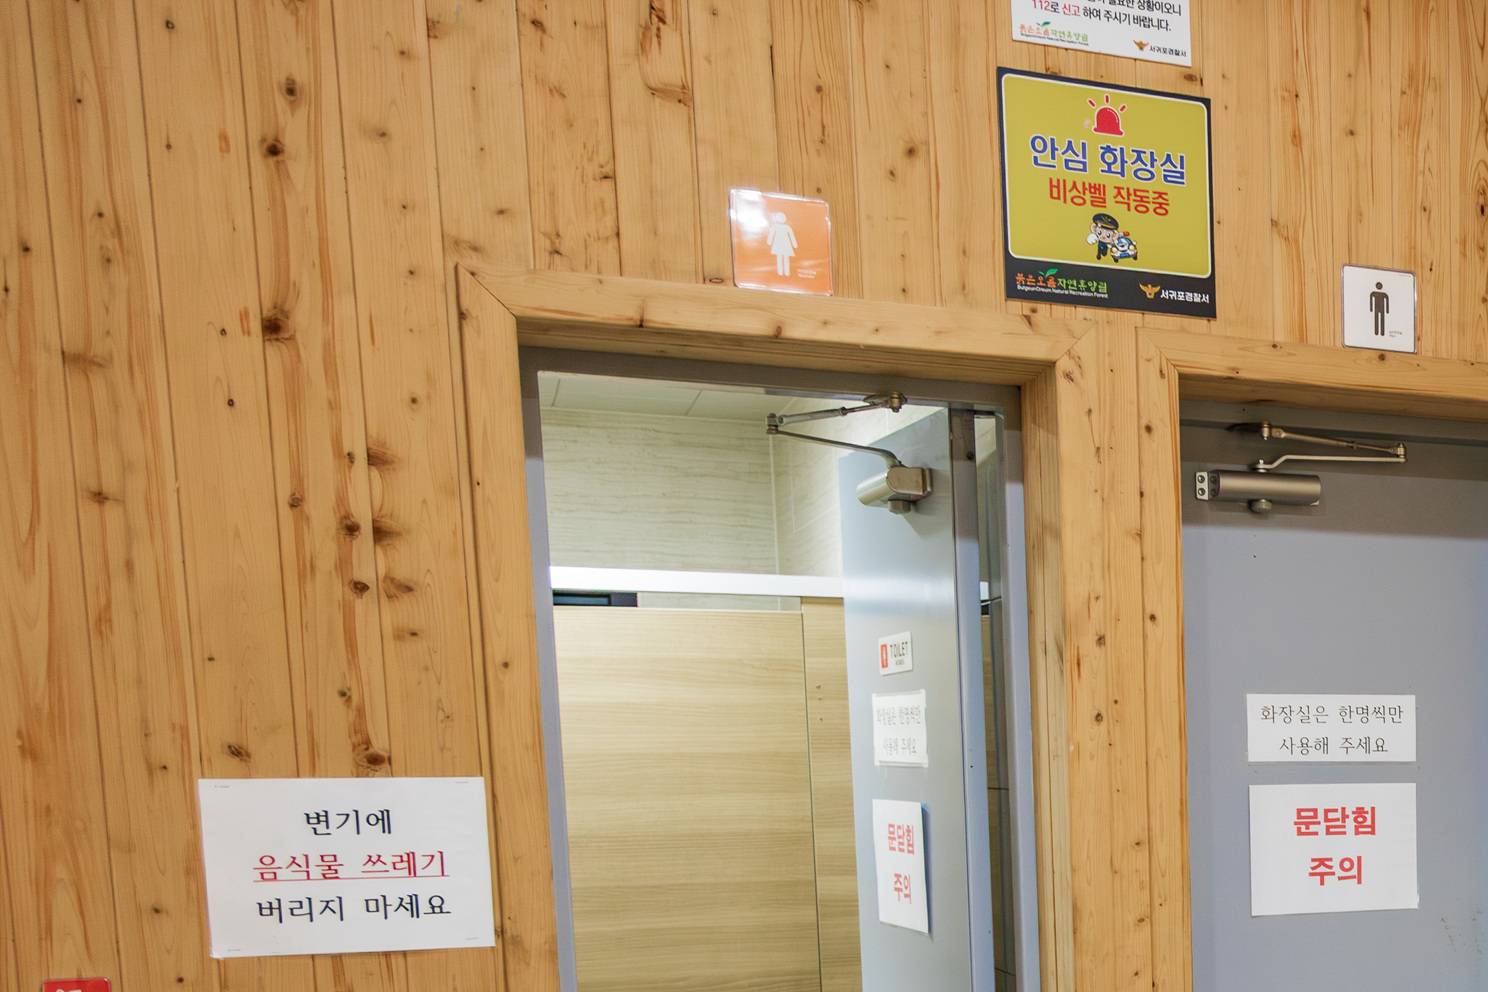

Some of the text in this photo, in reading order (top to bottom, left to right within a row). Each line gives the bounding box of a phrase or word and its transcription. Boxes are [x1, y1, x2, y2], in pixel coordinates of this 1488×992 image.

[1031, 0, 1172, 32] 112로 신고 하여 주시기 바랍니다.
[1029, 134, 1187, 187] 안심 화장실
[1049, 176, 1170, 217] 비상벨 작동중
[1160, 288, 1210, 304] 서귀포경찰서
[889, 640, 908, 659] TOILET
[1260, 704, 1405, 725] 화장실은 한명씩만
[1279, 736, 1389, 756] 사용해 주세요
[303, 808, 393, 836] 변기에
[1293, 806, 1377, 837] 문닫힘
[887, 822, 915, 855] 문닫힘
[253, 850, 447, 881] 음식물 쓰레기
[1308, 855, 1363, 887] 주의
[893, 873, 912, 905] 주의
[256, 893, 452, 924] 버리지 마세요
